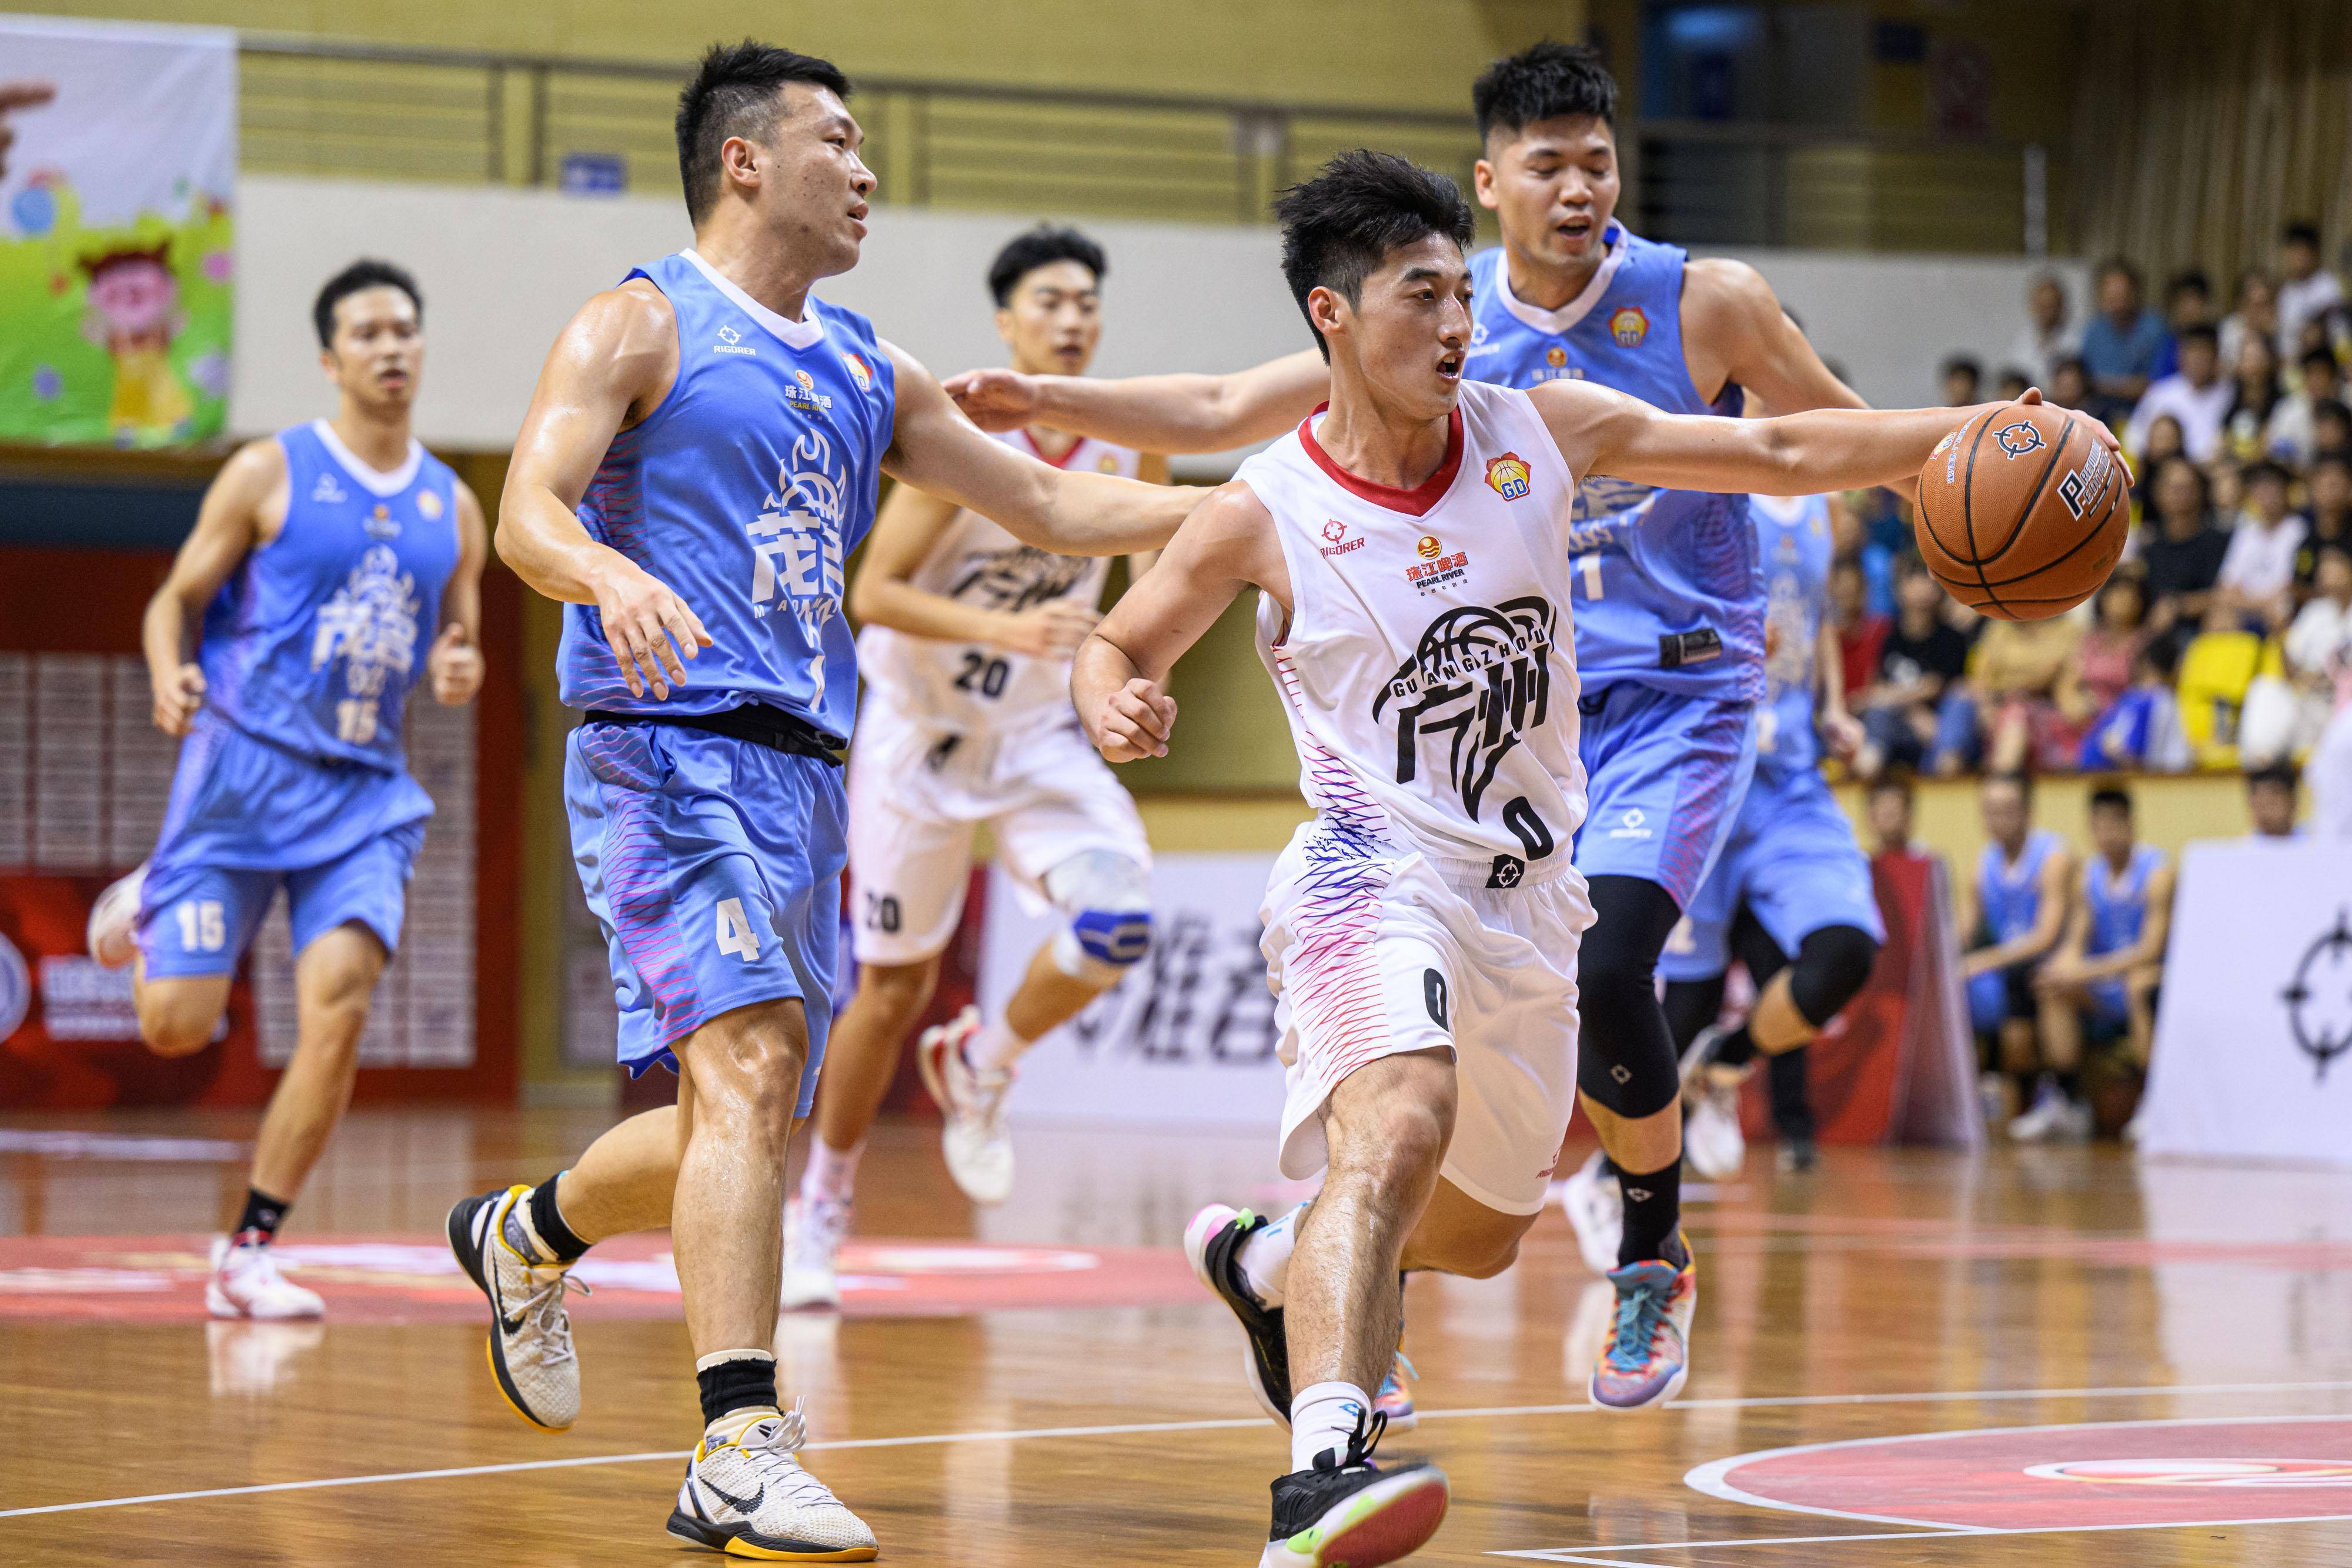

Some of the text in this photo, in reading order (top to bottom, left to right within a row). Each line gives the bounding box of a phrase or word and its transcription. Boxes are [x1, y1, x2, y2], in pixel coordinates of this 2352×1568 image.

[713, 345, 756, 356] RIGORER
[790, 400, 811, 411] PEARL
[1501, 478, 1528, 499] GD
[1319, 537, 1365, 559] RIGORER
[1405, 551, 1469, 581] 珠江啤酒
[1416, 569, 1465, 589] PEARL RIVER
[953, 650, 1009, 699] 20
[1392, 628, 1545, 698] GUANGZHOU
[336, 700, 378, 743] 15
[1502, 796, 1554, 861] 0
[178, 901, 226, 952] 15
[716, 897, 761, 962] 4
[867, 892, 900, 934] 20
[1424, 968, 1449, 1032] 0
